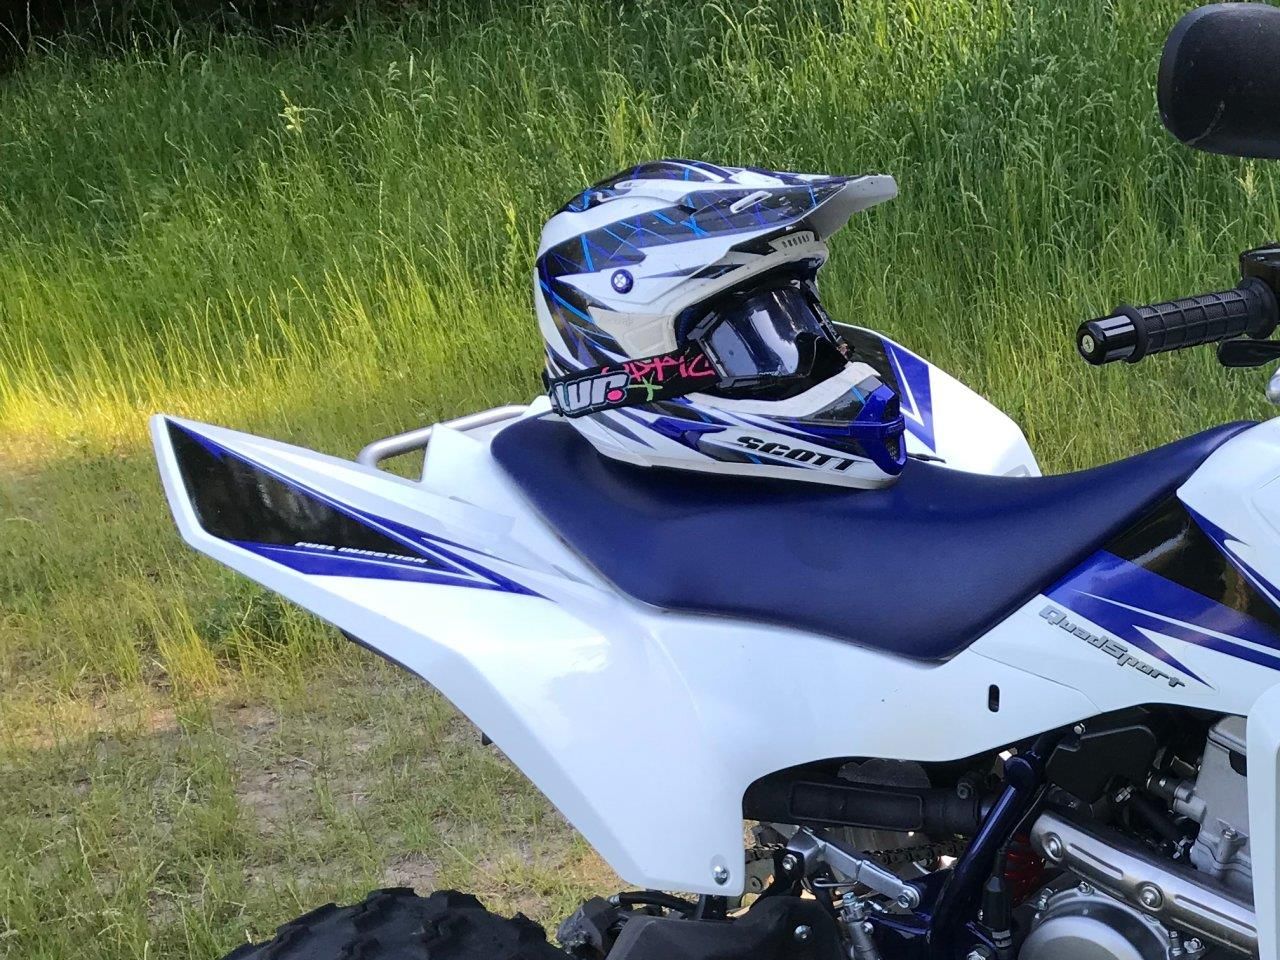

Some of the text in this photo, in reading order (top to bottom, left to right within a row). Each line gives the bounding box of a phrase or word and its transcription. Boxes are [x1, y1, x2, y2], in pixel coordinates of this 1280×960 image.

[736, 436, 870, 472] SCOTT
[339, 547, 428, 564] INJECTION
[1037, 603, 1186, 690] QuadSport
